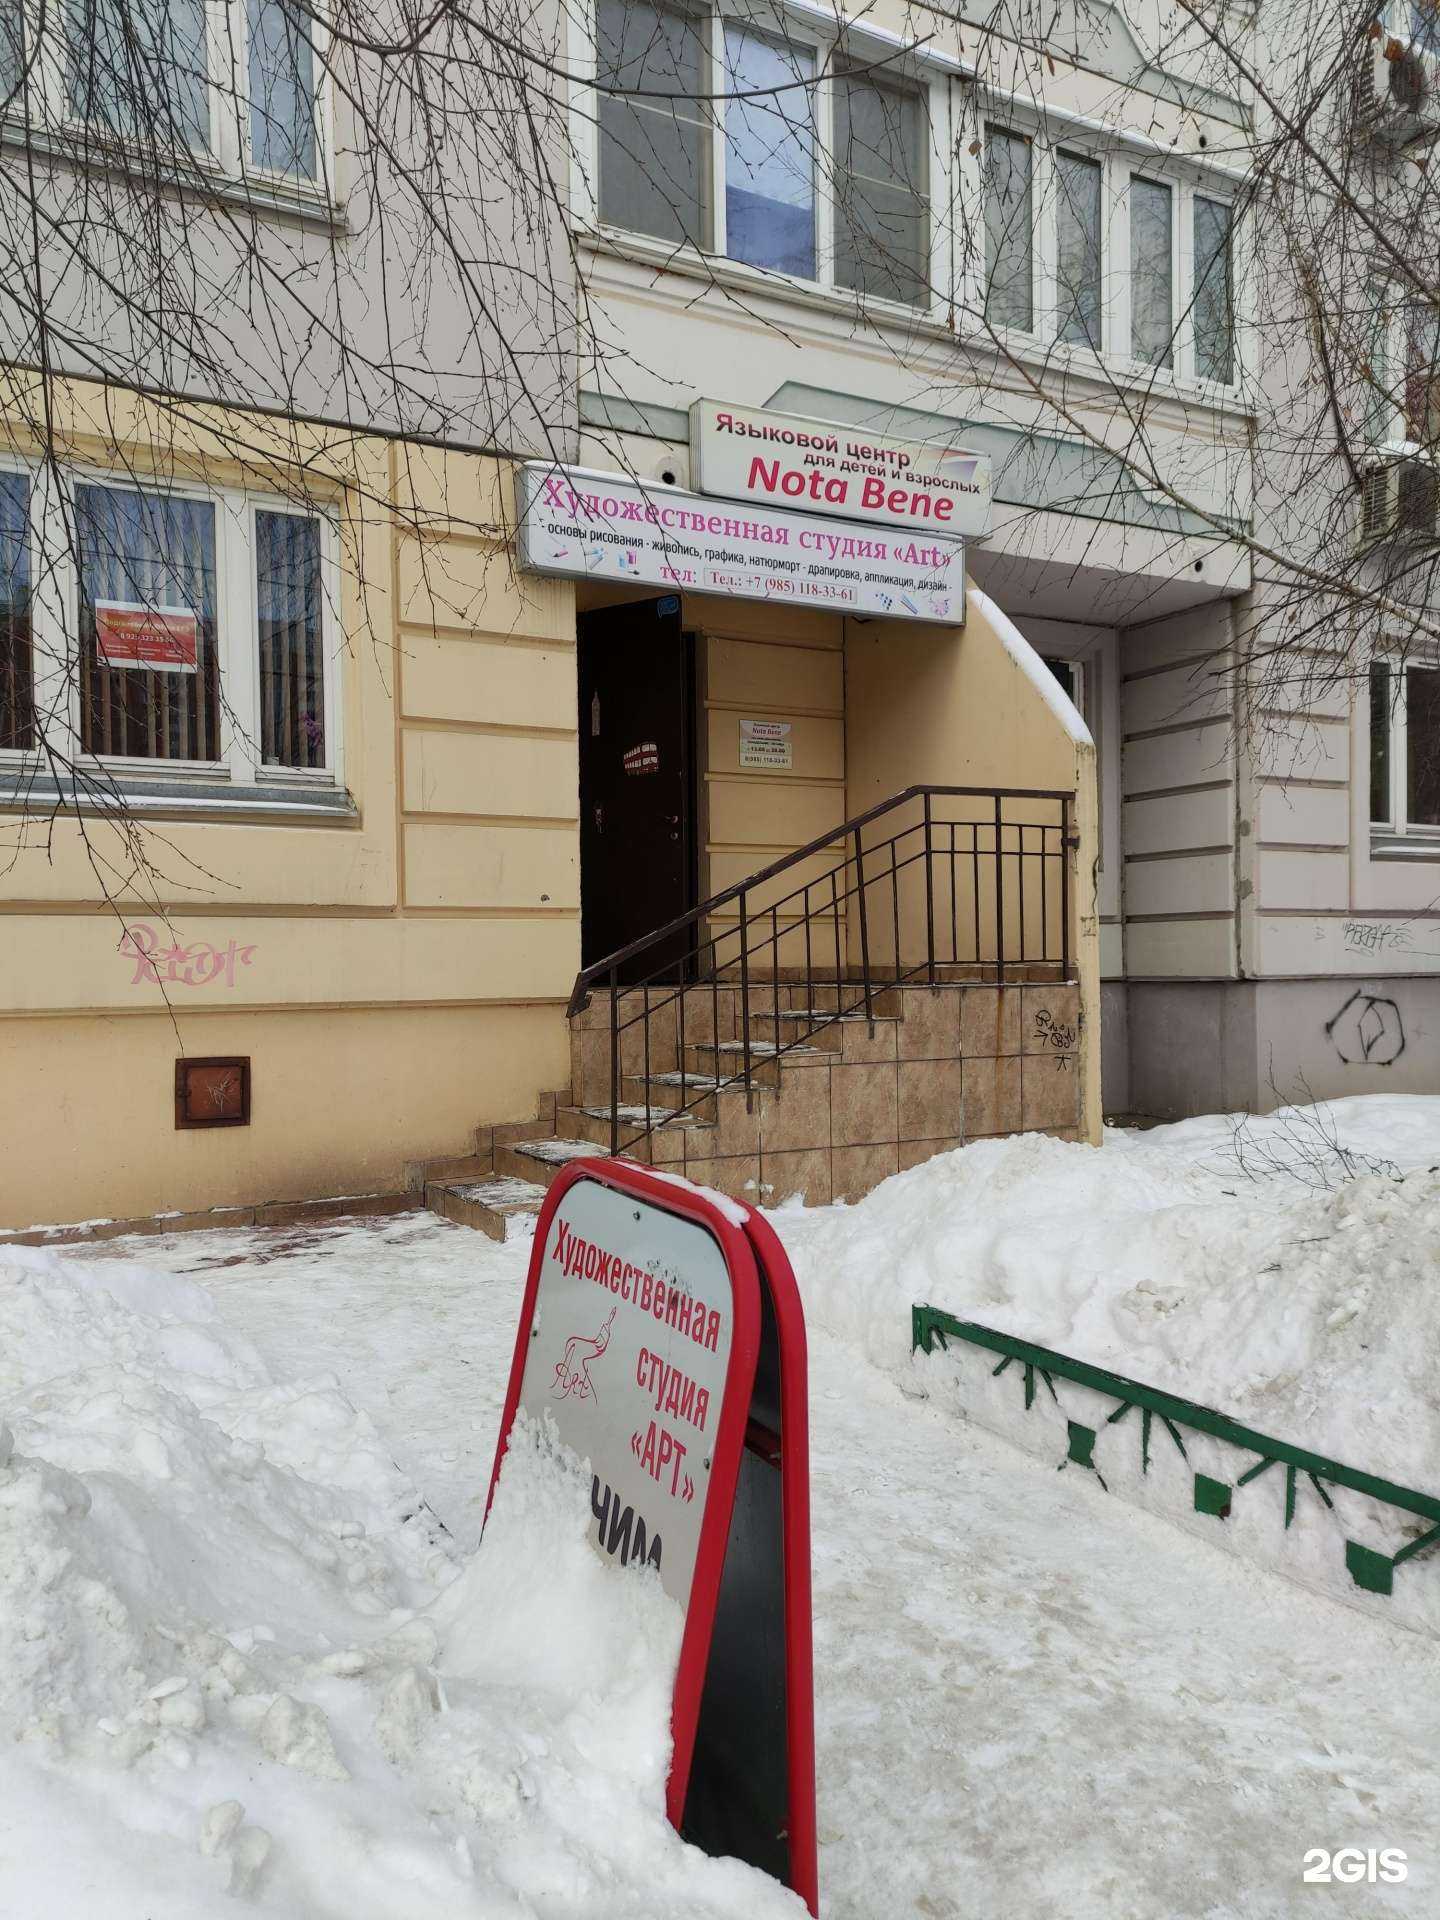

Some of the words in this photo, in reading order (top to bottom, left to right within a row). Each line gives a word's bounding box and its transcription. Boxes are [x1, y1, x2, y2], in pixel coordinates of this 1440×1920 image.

[716, 413, 838, 453] Языковой
[846, 442, 911, 469] центр
[804, 453, 835, 468] для
[840, 460, 886, 477] детей
[892, 468, 900, 479] и
[906, 471, 981, 494] взрослых
[747, 456, 848, 504] Nota
[861, 477, 954, 520] Bene
[543, 478, 789, 545] Художественная
[799, 531, 887, 560] студия
[893, 543, 951, 568] «Art»
[548, 523, 587, 539] основы
[590, 530, 644, 549] рисования
[652, 540, 702, 559] живопись,
[704, 549, 747, 566] графика,
[749, 555, 801, 573] натюрморт
[808, 564, 862, 582] драпировка,
[864, 571, 916, 590] аппликация,
[917, 579, 947, 592] дизайн
[660, 567, 697, 583] тел:
[746, 577, 760, 589] +7
[765, 577, 795, 594] (985)
[800, 583, 852, 600] 118-33-61
[552, 1218, 721, 1352] Художественная
[636, 1347, 710, 1432] студия
[631, 1421, 695, 1503] «АРТ»
